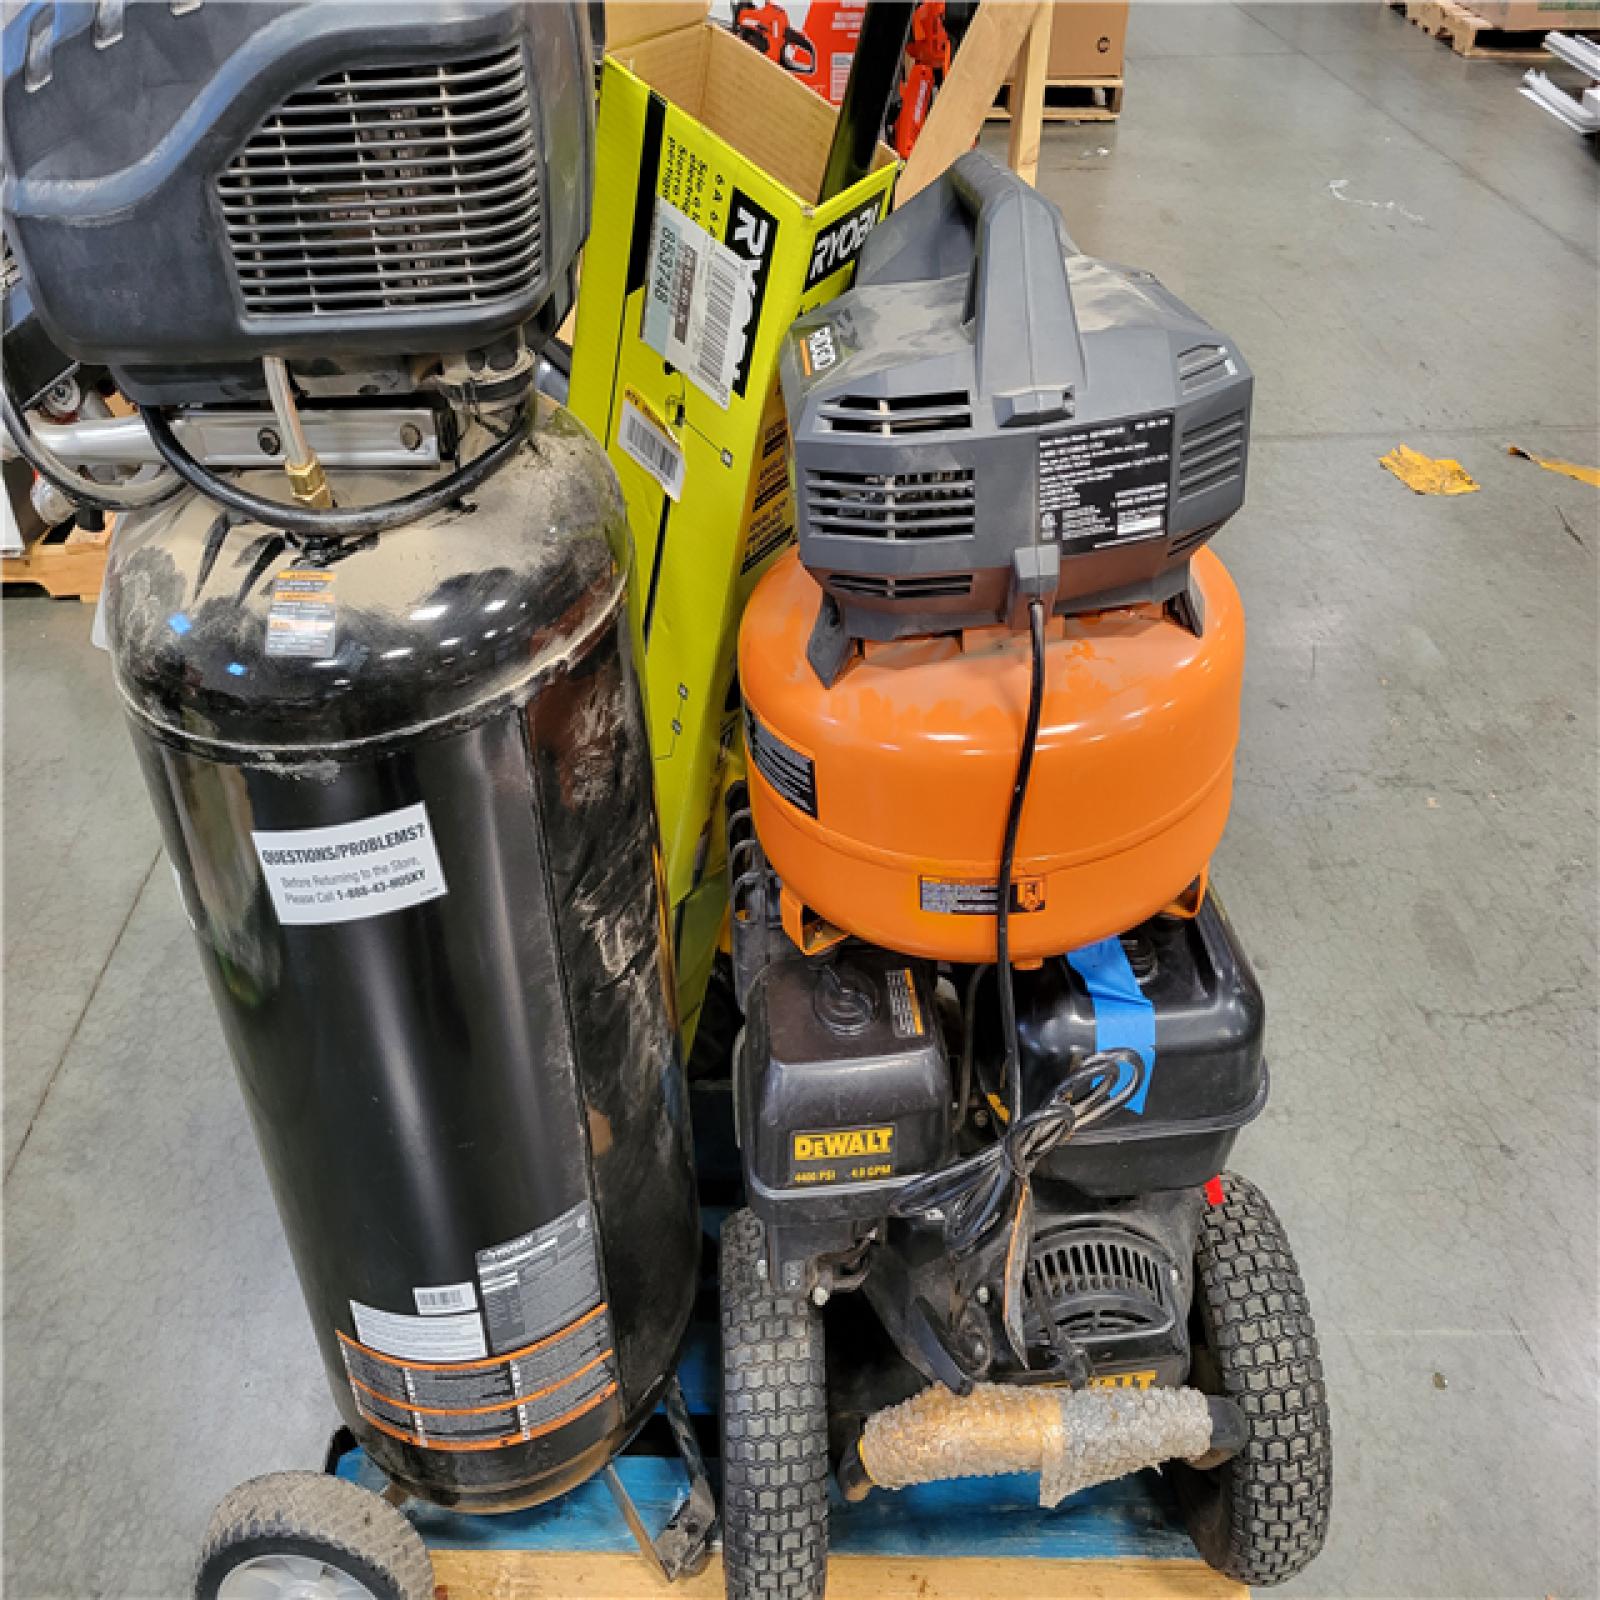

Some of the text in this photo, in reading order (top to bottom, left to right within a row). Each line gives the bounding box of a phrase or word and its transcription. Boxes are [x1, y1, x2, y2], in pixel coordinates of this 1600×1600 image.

[810, 202, 880, 281] RYOBI
[261, 822, 426, 866] QUESTIONS/PROBLEMS?
[360, 869, 371, 880] to
[372, 864, 390, 877] the
[794, 1126, 894, 1161] DEWALT
[819, 1169, 836, 1182] PSI
[867, 1164, 891, 1178] GPM
